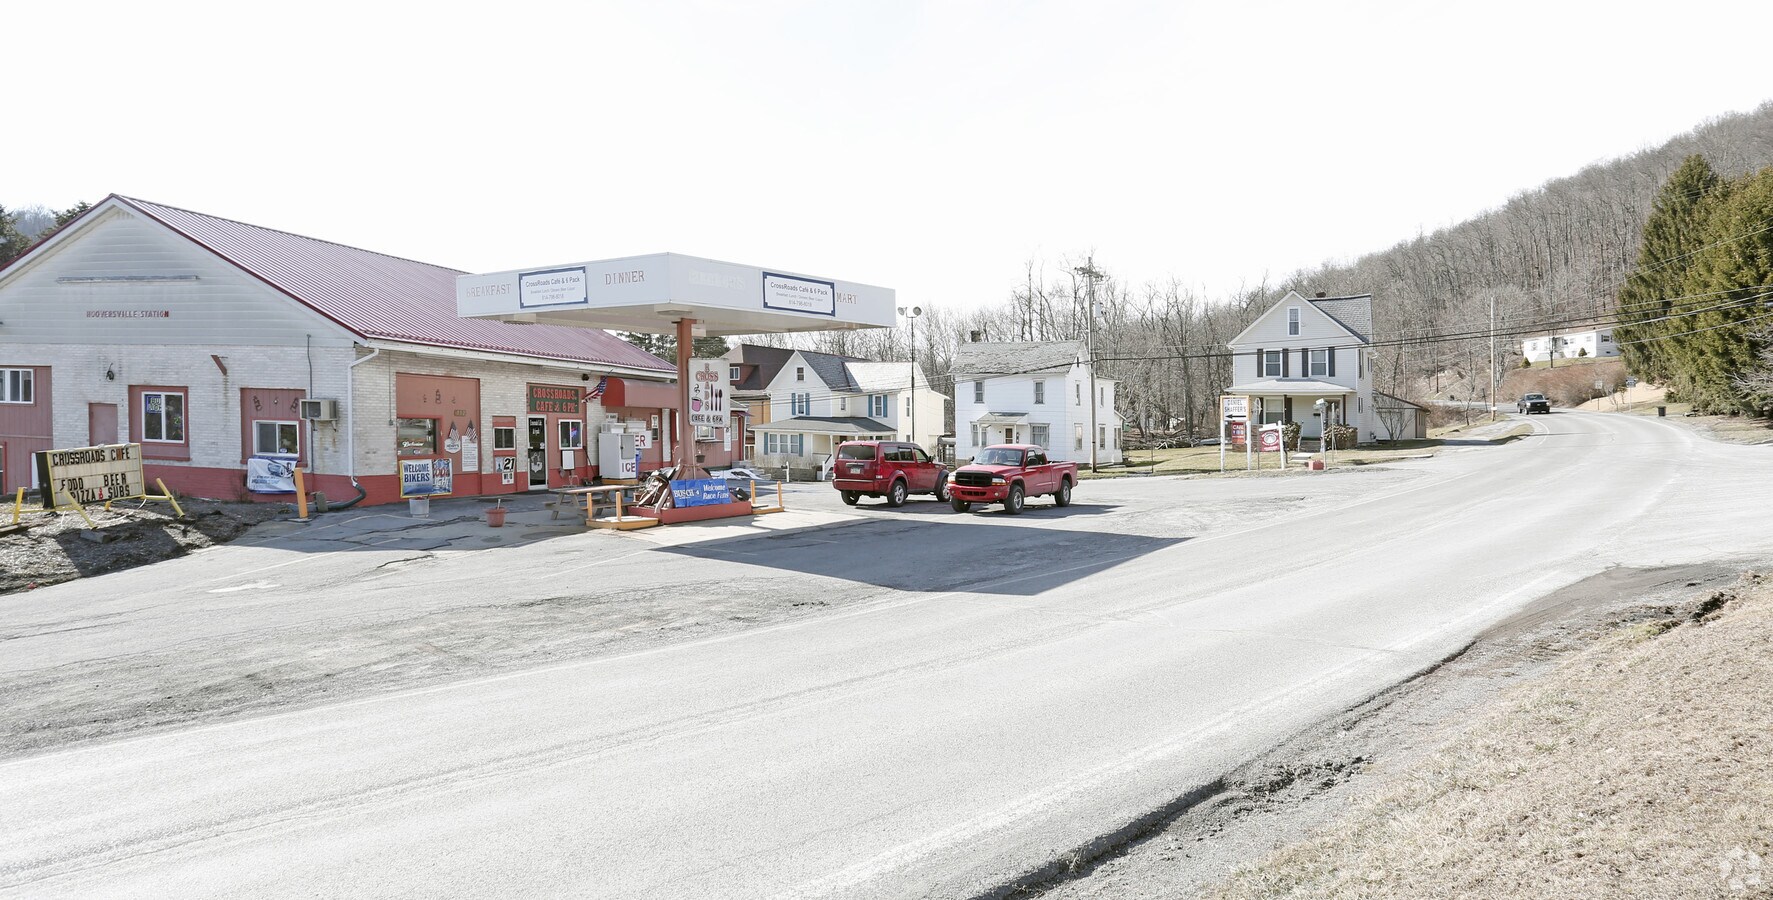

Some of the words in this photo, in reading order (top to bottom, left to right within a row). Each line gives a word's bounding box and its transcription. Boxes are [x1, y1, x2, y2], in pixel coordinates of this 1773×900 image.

[525, 279, 550, 287] CrossRoads
[569, 275, 580, 283] Pack
[605, 270, 645, 285] DINNER
[466, 284, 511, 297] BREAKFAST
[770, 281, 798, 292] CrossRoads
[836, 291, 857, 304] MART
[86, 310, 137, 318] HOOVERSVILLE
[140, 310, 169, 318] STATION
[695, 370, 719, 382] CROSS
[532, 387, 575, 400] CROSSROADS
[536, 400, 553, 412] CAFE
[691, 414, 705, 423] CAFE
[706, 415, 711, 423] &
[52, 450, 105, 466] CROSSROADS
[111, 448, 130, 461] CAFE
[403, 463, 430, 473] WELCOME
[503, 457, 515, 470] 21
[621, 462, 636, 473] ICE
[60, 477, 84, 491] FOOD
[103, 473, 127, 487] BEER
[404, 472, 430, 482] BIKERS
[70, 488, 96, 503] PIZZA
[107, 485, 130, 498] SUBS
[673, 488, 695, 498] BUSCH
[717, 491, 729, 499] Fans
